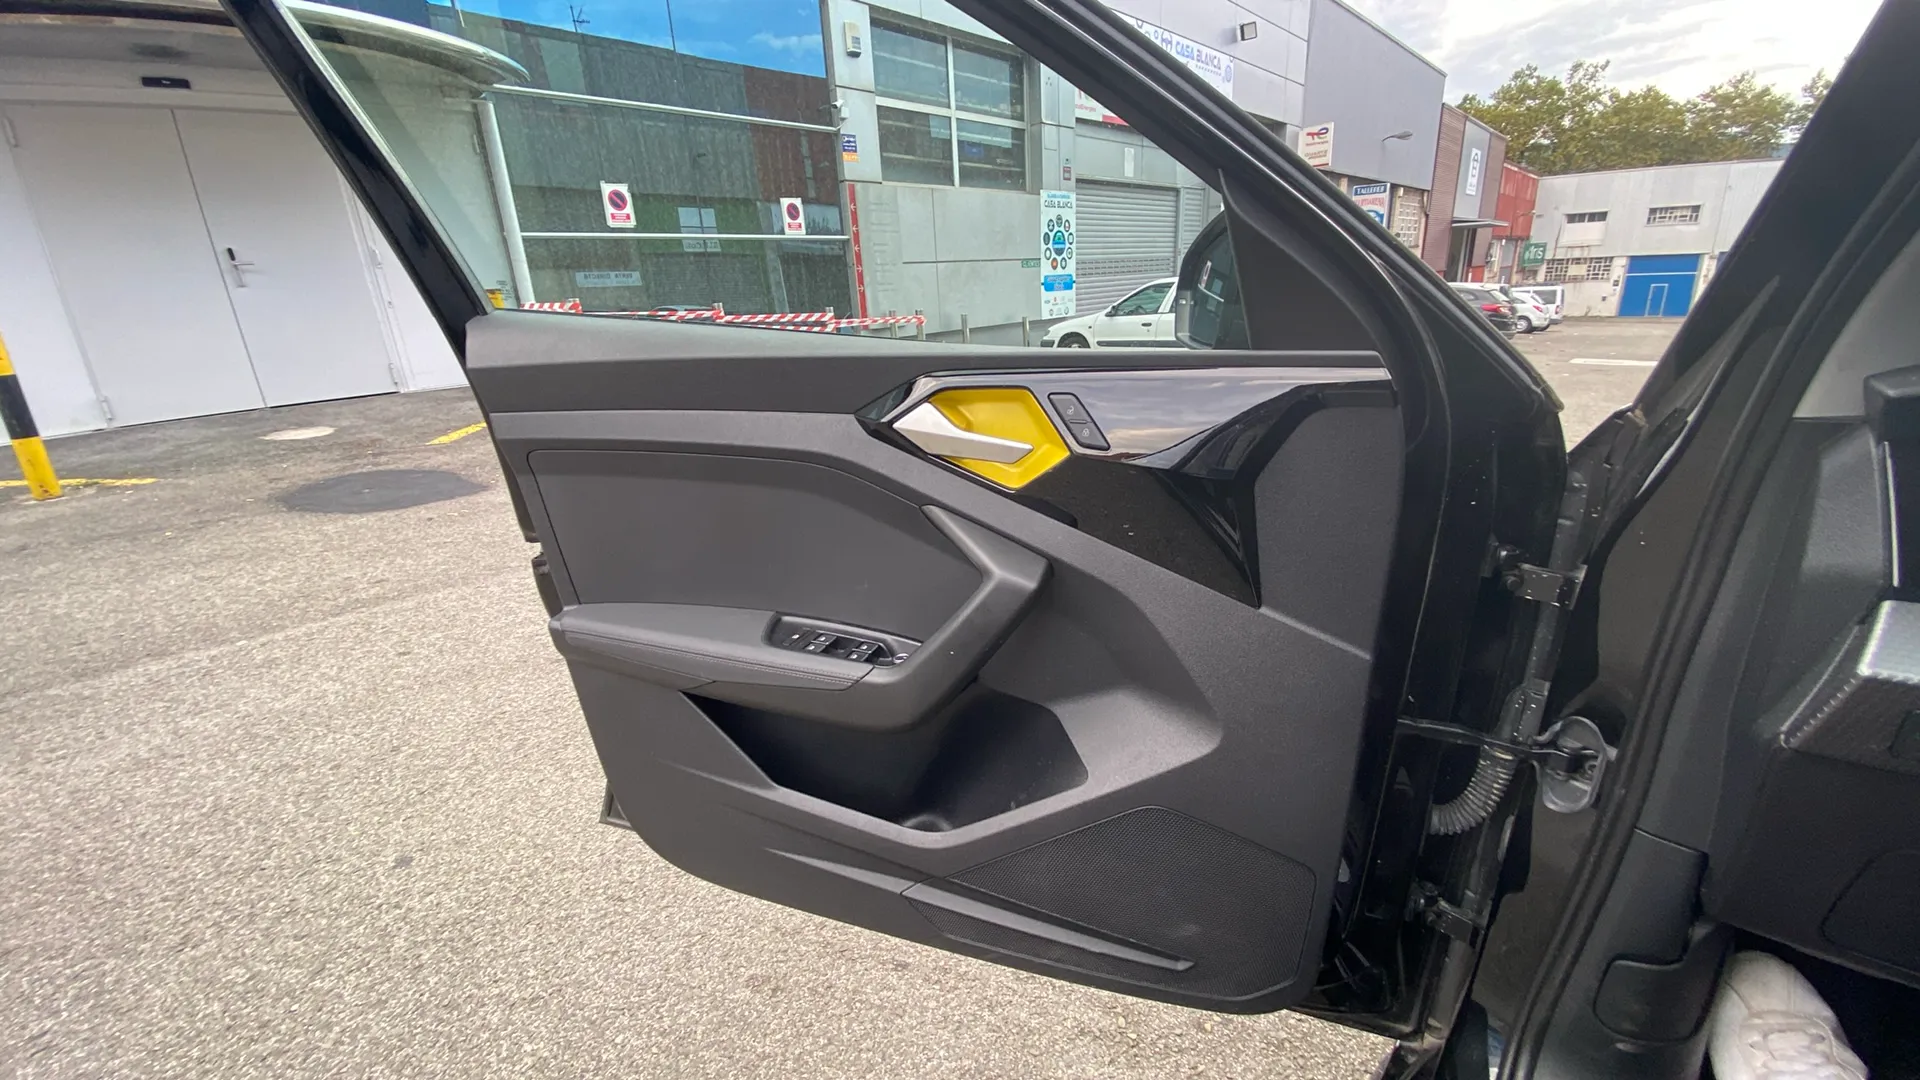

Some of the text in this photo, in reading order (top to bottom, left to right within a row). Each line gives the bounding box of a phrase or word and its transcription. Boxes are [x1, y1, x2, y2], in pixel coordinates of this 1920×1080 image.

[1175, 41, 1195, 61] CASA
[1196, 50, 1222, 70] BLANCA
[1044, 200, 1073, 209] CASA BLANCA
